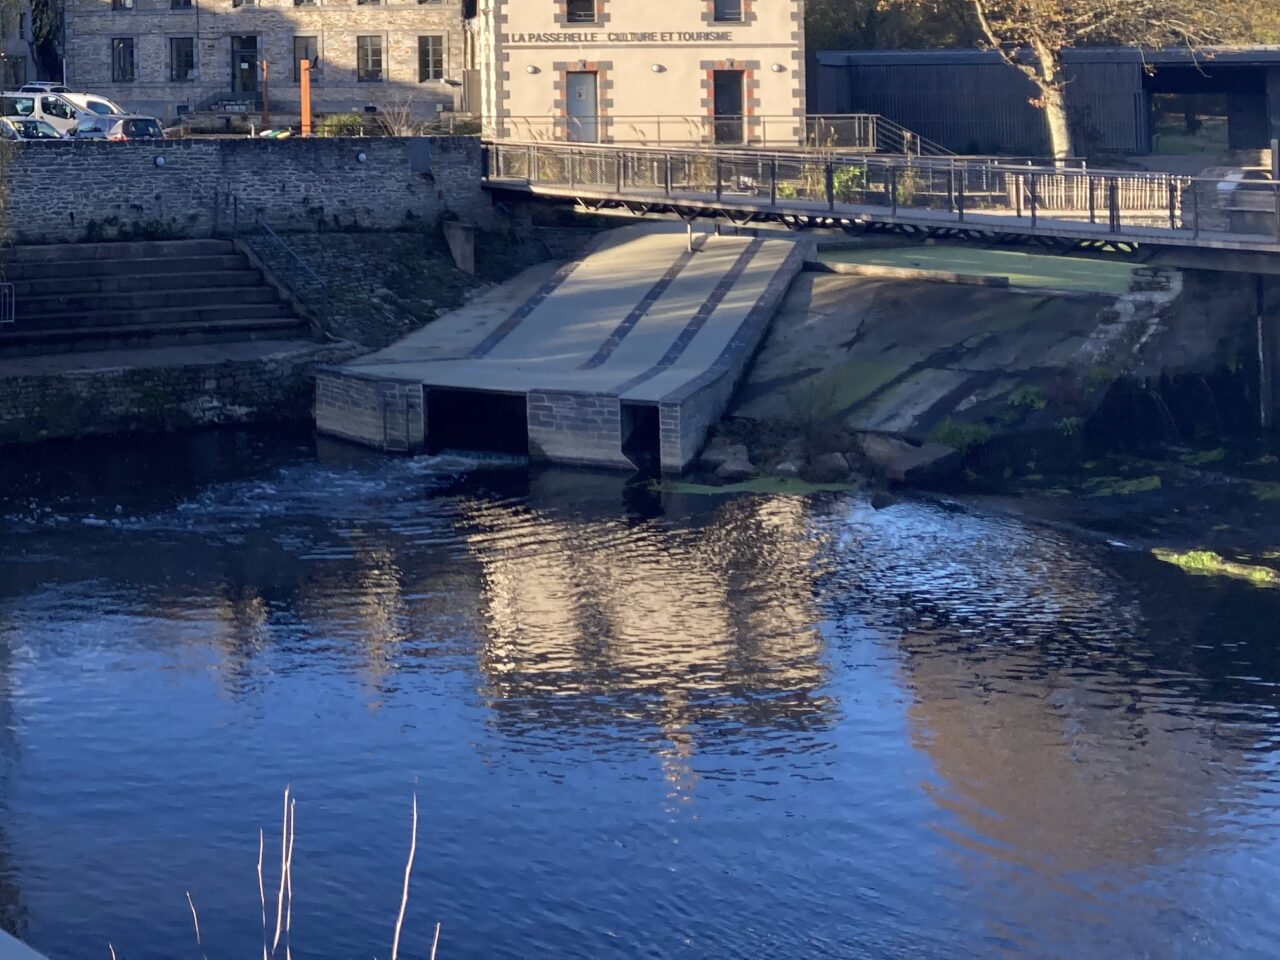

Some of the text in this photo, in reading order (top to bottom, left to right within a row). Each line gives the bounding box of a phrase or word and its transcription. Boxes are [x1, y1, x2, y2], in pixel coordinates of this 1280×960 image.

[511, 31, 733, 43] LA PASSERELLE CULTURE ET TOURISME
